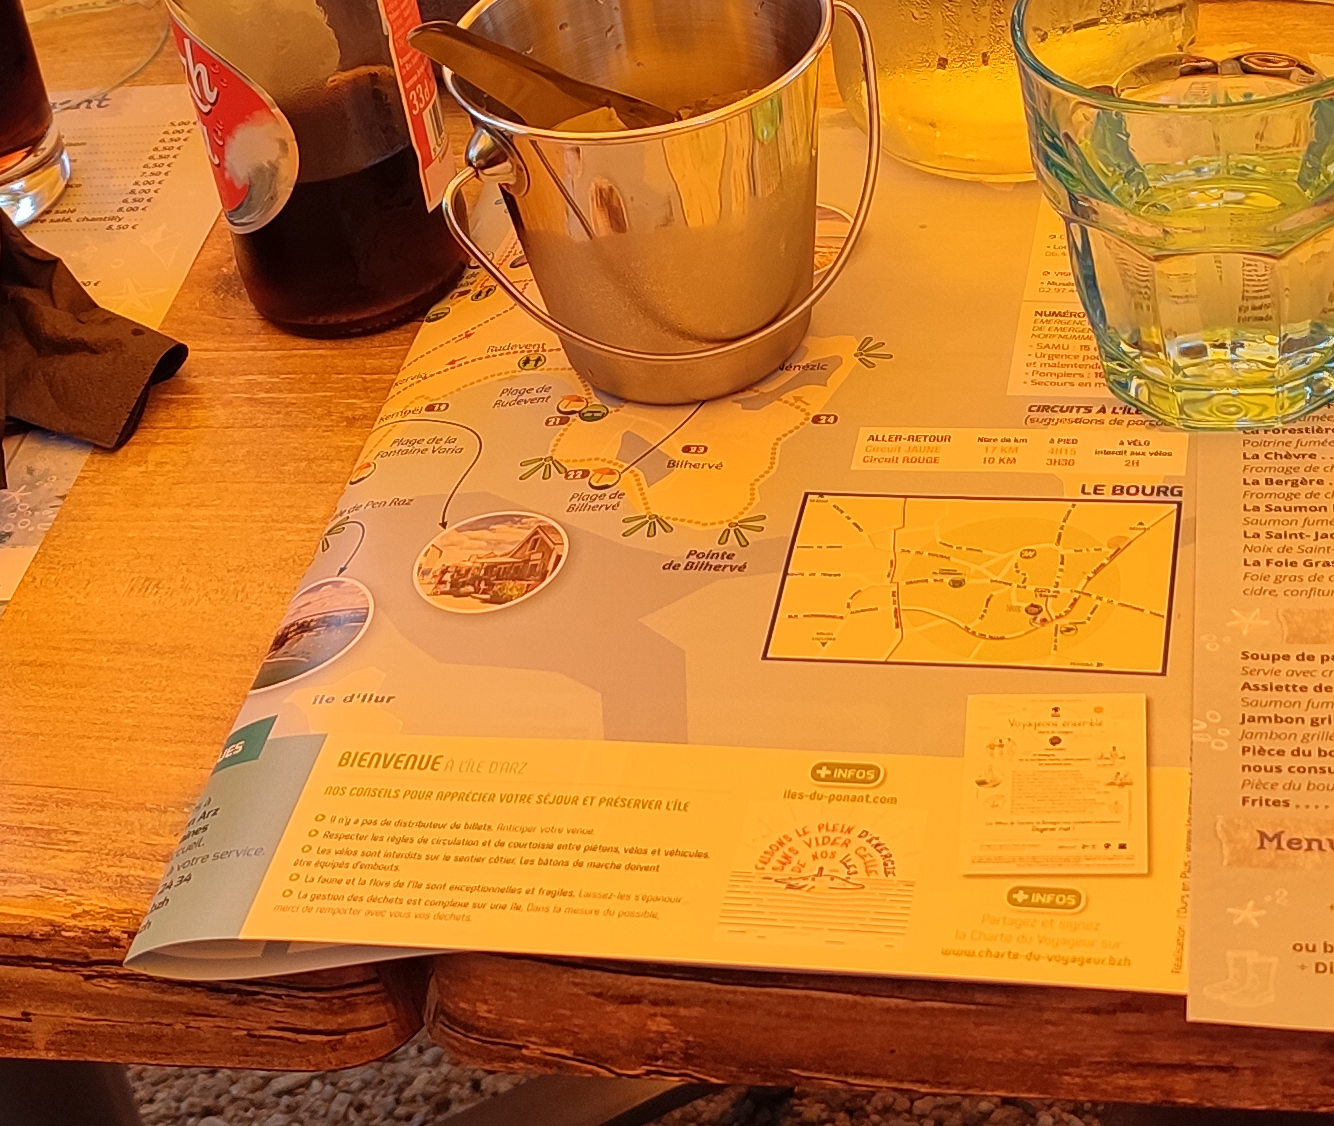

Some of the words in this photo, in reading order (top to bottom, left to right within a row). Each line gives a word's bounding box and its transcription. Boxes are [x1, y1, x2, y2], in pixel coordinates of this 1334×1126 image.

[499, 386, 531, 398] Plage
[535, 385, 552, 395] de
[493, 395, 552, 409] Rudevent
[1027, 404, 1093, 414] CIRCUITS
[867, 435, 951, 443] ALLER-RETOUR
[1242, 438, 1292, 448] Poitrine
[1243, 451, 1260, 460] La
[1264, 450, 1317, 460] Chèvre
[1242, 463, 1300, 475] Fromage
[1304, 463, 1319, 472] de
[1243, 477, 1260, 486] La
[1265, 476, 1324, 488] Bergère
[1081, 484, 1105, 495] LE
[1112, 485, 1183, 497] BOURG
[1243, 504, 1260, 512] La
[1264, 503, 1327, 512] Saumon
[1243, 530, 1260, 539] La
[686, 550, 736, 561] Pointe
[662, 560, 681, 571] de
[683, 559, 747, 573] Bilhervé
[1243, 558, 1261, 567] La
[1266, 557, 1298, 567] Foie
[1241, 650, 1290, 663] Soupe
[1295, 650, 1315, 662] de
[1241, 681, 1309, 693] Assiette
[1314, 682, 1334, 693] de
[1240, 713, 1305, 726] Jambon
[1241, 746, 1286, 758] Pièce
[1291, 746, 1312, 758] du
[338, 751, 443, 772] BIENVENUE
[833, 768, 876, 781] INFOS
[1241, 764, 1283, 774] nous
[324, 786, 346, 797] NOS
[349, 786, 399, 799] CONSEILS
[403, 788, 433, 801] POUR
[436, 788, 496, 803] APPRÉCIER
[499, 792, 534, 804] VOTRE
[536, 791, 579, 806] SÉJOUR
[583, 795, 595, 805] ET
[599, 794, 662, 810] PRÉSERVER
[1241, 796, 1290, 808] Frites
[1031, 892, 1077, 905] INFOS
[1292, 942, 1317, 953] ou
